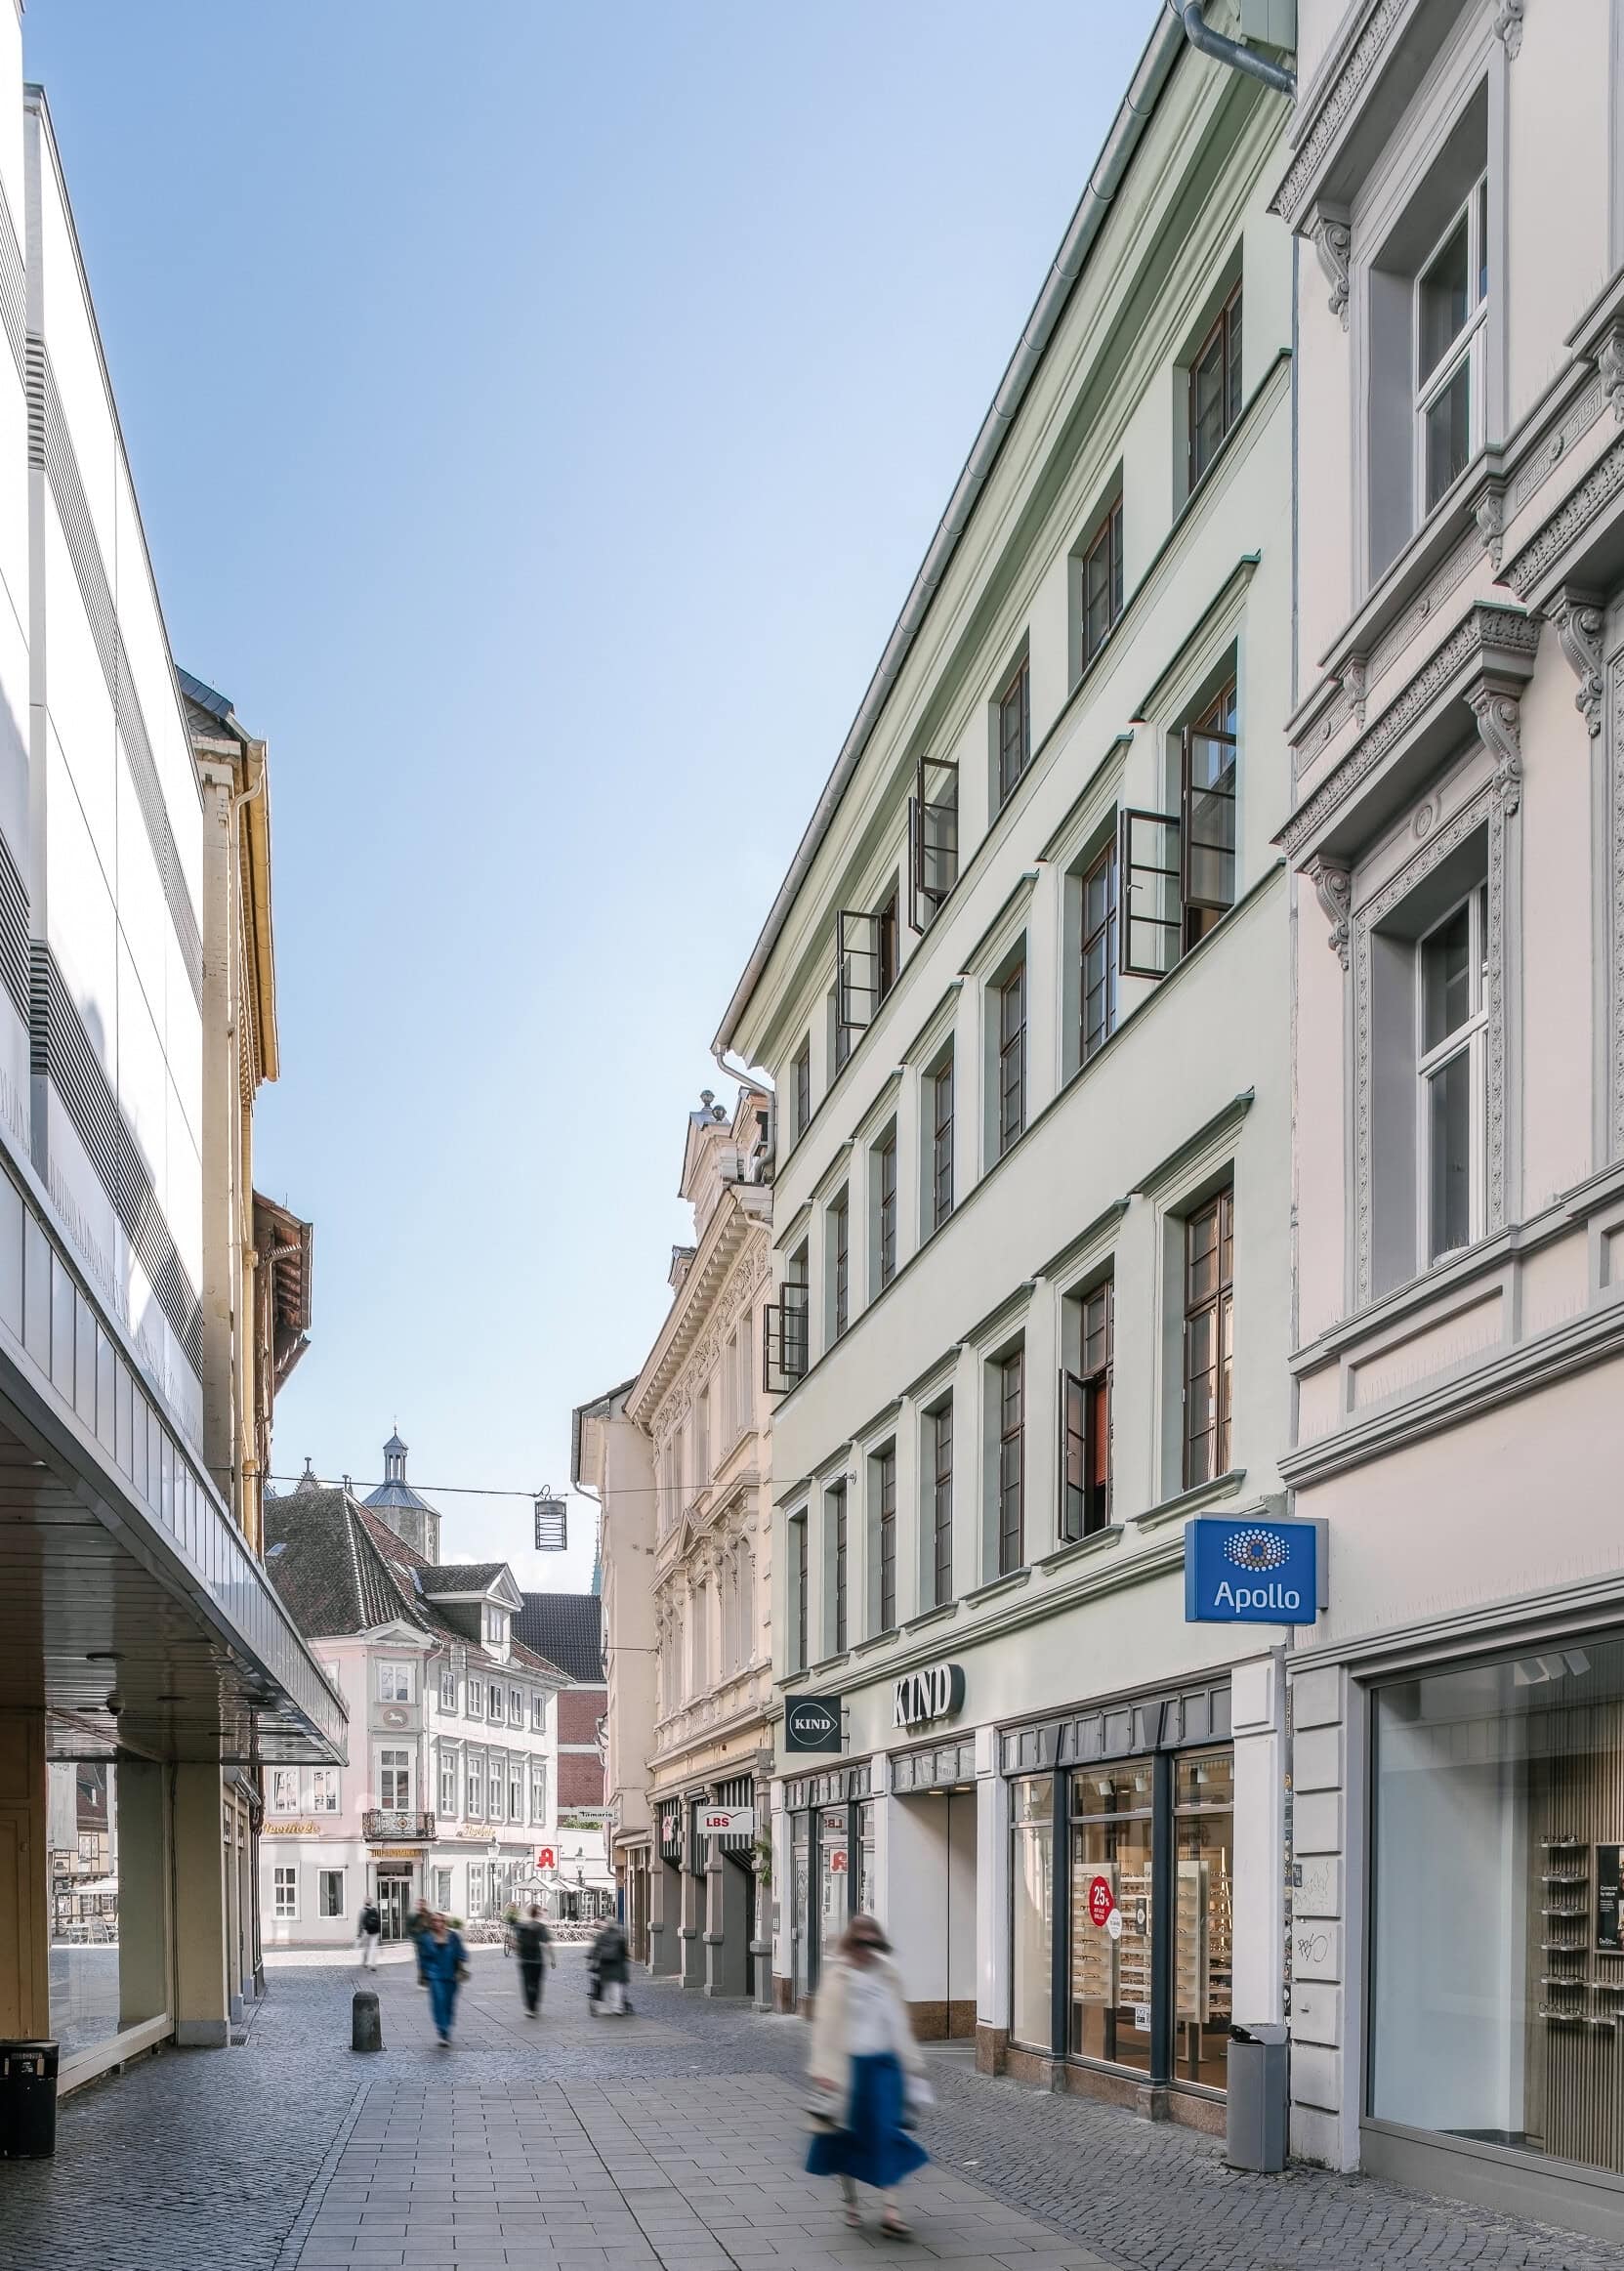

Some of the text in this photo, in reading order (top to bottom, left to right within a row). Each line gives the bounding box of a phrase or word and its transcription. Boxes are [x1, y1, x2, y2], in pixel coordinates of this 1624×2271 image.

[1214, 1581, 1300, 1614] Apollo
[891, 1663, 955, 1729] KIND
[795, 1718, 831, 1730] KIND
[706, 1818, 729, 1828] LBS
